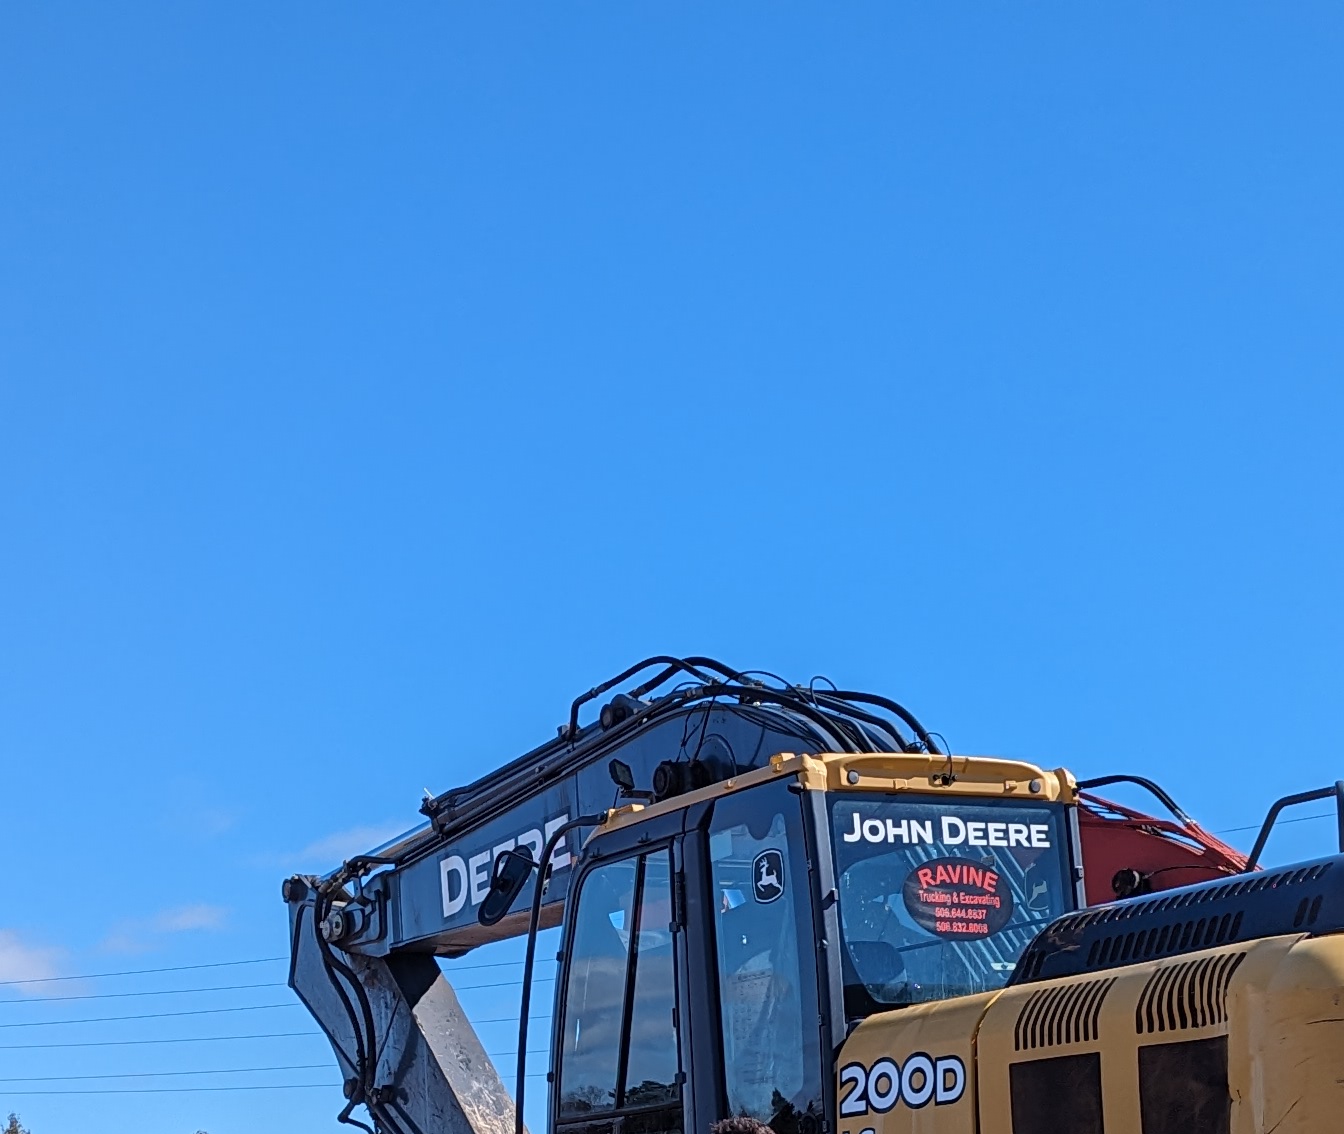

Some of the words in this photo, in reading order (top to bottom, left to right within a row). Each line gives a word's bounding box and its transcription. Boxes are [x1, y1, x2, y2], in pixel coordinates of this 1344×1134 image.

[843, 812, 933, 844] JOHN
[941, 815, 1051, 848] DEERE
[917, 864, 999, 893] RAVINE
[918, 889, 952, 905] Trucking
[952, 892, 959, 903] &
[959, 892, 1001, 908] Excavating
[840, 1051, 966, 1118] 200D
